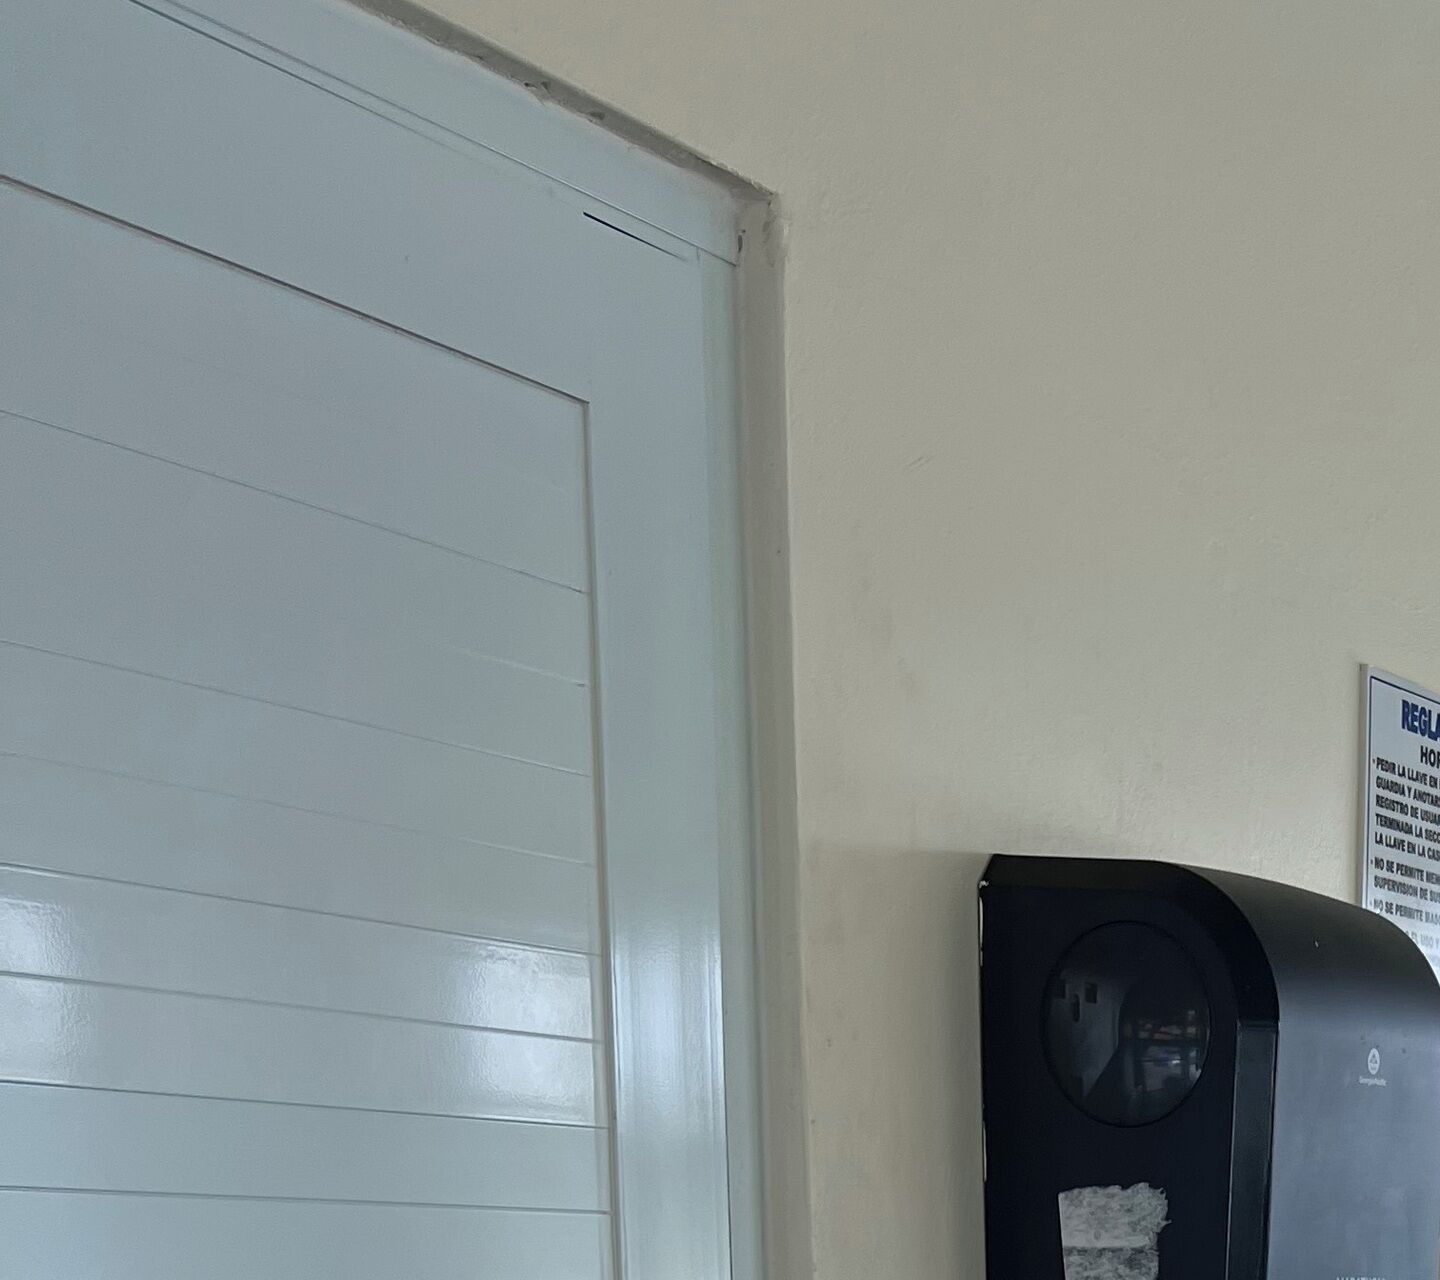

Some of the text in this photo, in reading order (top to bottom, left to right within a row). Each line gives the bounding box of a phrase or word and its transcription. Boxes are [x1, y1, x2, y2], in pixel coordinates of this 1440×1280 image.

[1376, 757, 1396, 775] PEDIR
[1398, 764, 1406, 778] LA
[1407, 767, 1427, 786] LLAVE
[1429, 775, 1438, 789] EN
[1407, 786, 1412, 799] Y
[1375, 794, 1409, 816] REGISTRO
[1410, 805, 1419, 820] DE
[1415, 825, 1423, 839] LA
[1375, 831, 1383, 846] LA
[1385, 834, 1405, 852] LLAVE
[1407, 841, 1416, 854] EN
[1418, 843, 1426, 858] LA
[1374, 856, 1384, 870] NO
[1386, 860, 1394, 873] SE
[1396, 862, 1424, 882] PERMITE
[1419, 887, 1428, 901] DE
[1373, 898, 1384, 912] NO
[1385, 901, 1394, 914] SE
[1395, 904, 1423, 921] PERMITE
